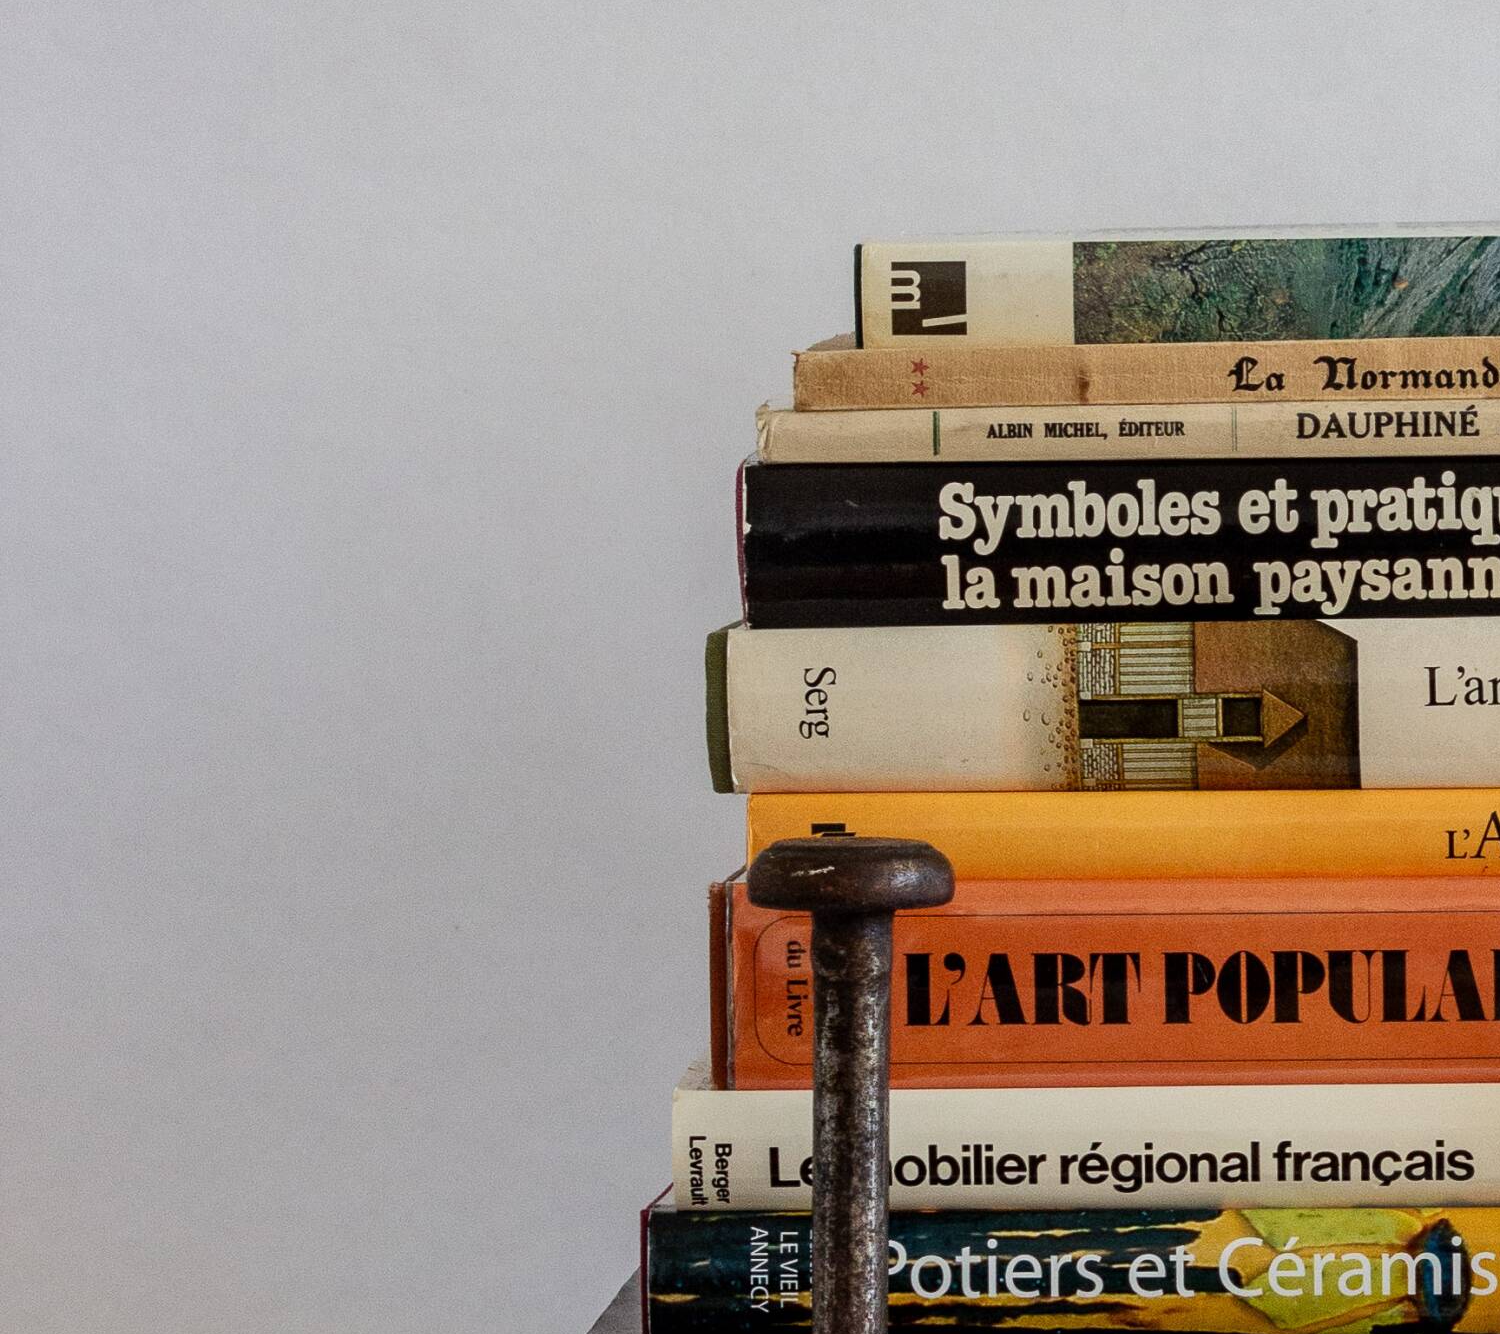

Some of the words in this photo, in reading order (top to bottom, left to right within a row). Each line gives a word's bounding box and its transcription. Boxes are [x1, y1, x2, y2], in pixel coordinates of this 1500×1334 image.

[1227, 356, 1286, 392] La
[986, 422, 1033, 439] ALBIN
[1043, 422, 1109, 441] MICHEL,
[1118, 418, 1186, 438] ÉDITEUR
[1296, 406, 1481, 440] DAUPHINÉ
[938, 479, 1221, 556] Symboles
[1238, 478, 1300, 535] et
[941, 555, 1000, 610] la
[1011, 547, 1235, 609] maison
[798, 666, 837, 740] Serg
[786, 940, 807, 969] du
[785, 978, 809, 1037] Livre
[902, 952, 1141, 1027] L'ART
[689, 1135, 709, 1207] Levrault
[711, 1143, 733, 1205] Berger
[886, 1144, 1047, 1188] obilier
[1059, 1141, 1261, 1194] régional
[1272, 1139, 1476, 1187] français
[750, 1225, 770, 1314] ANNECY
[779, 1231, 799, 1254] LE
[1127, 1238, 1196, 1298] et
[779, 1259, 799, 1309] VIEIL
